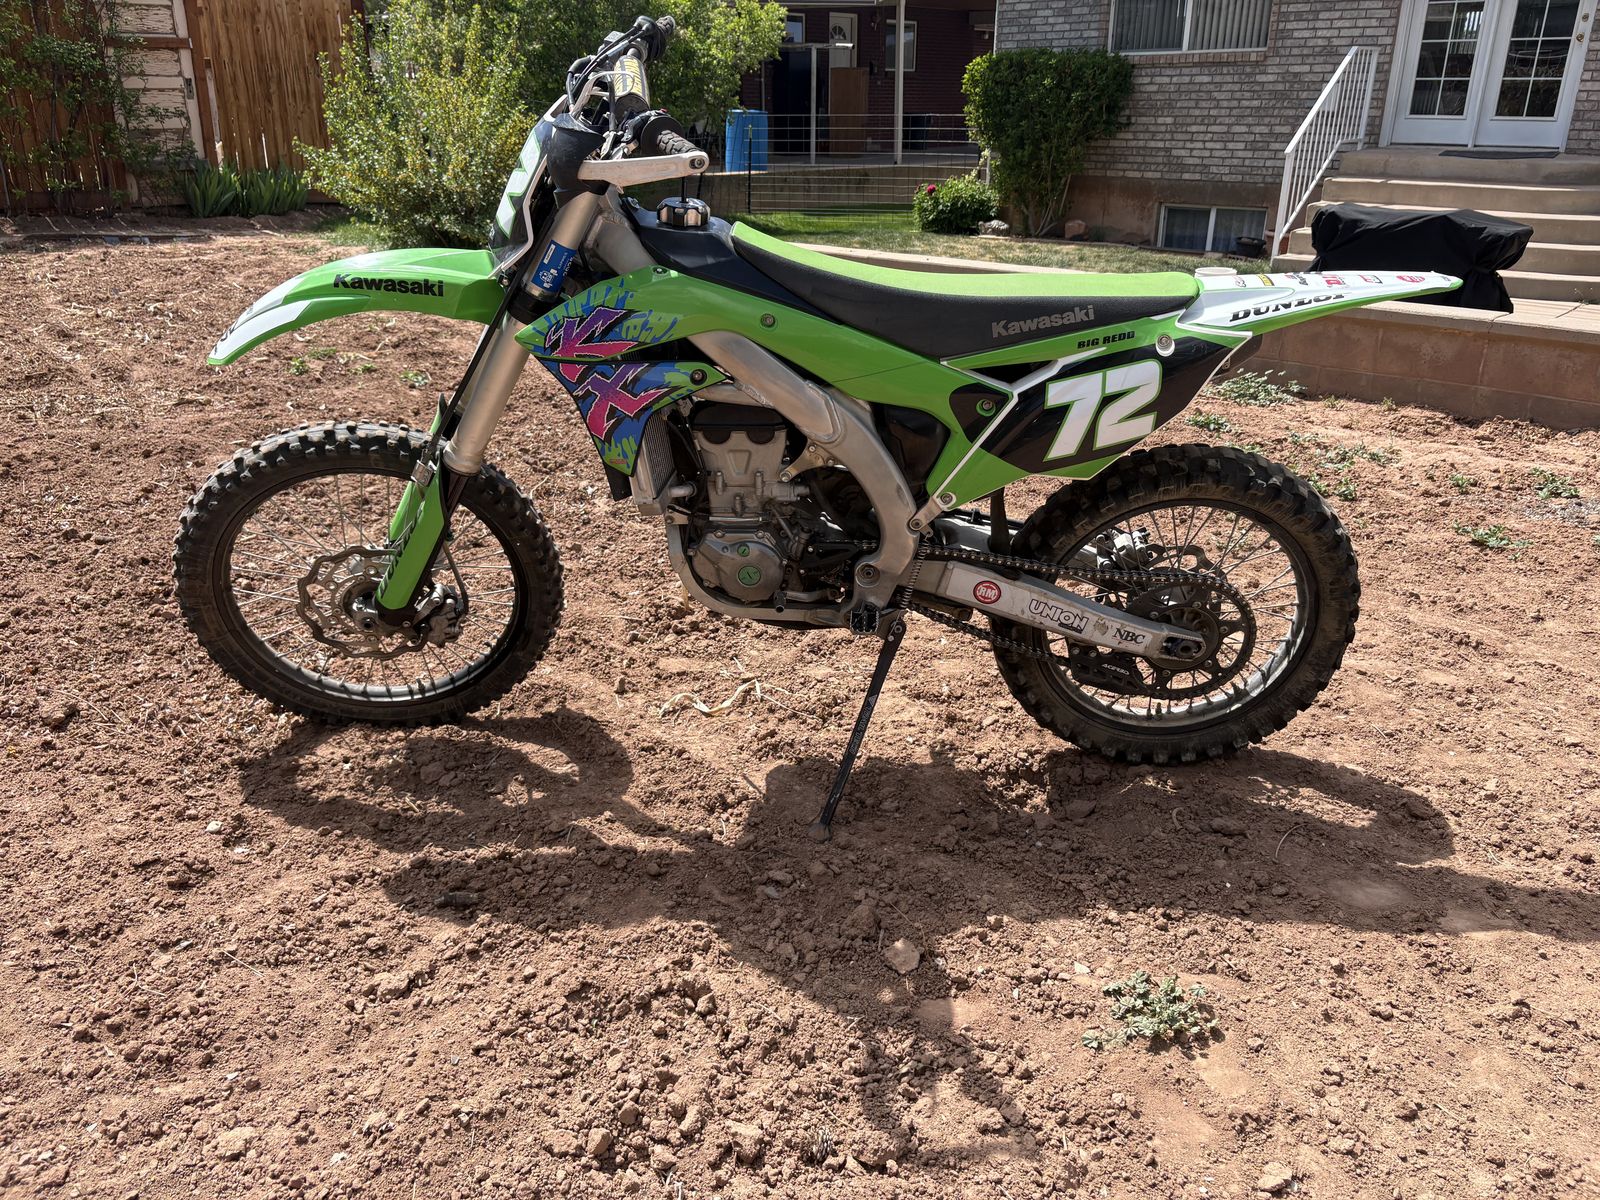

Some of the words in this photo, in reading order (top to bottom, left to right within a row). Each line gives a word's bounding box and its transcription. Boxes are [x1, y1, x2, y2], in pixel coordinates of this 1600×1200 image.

[333, 273, 444, 297] Kawasaki
[991, 304, 1095, 338] Kawasaki
[1077, 337, 1100, 350] BIG
[1044, 358, 1163, 462] 72
[1028, 599, 1090, 632] UNION
[1112, 627, 1146, 645] NBC
